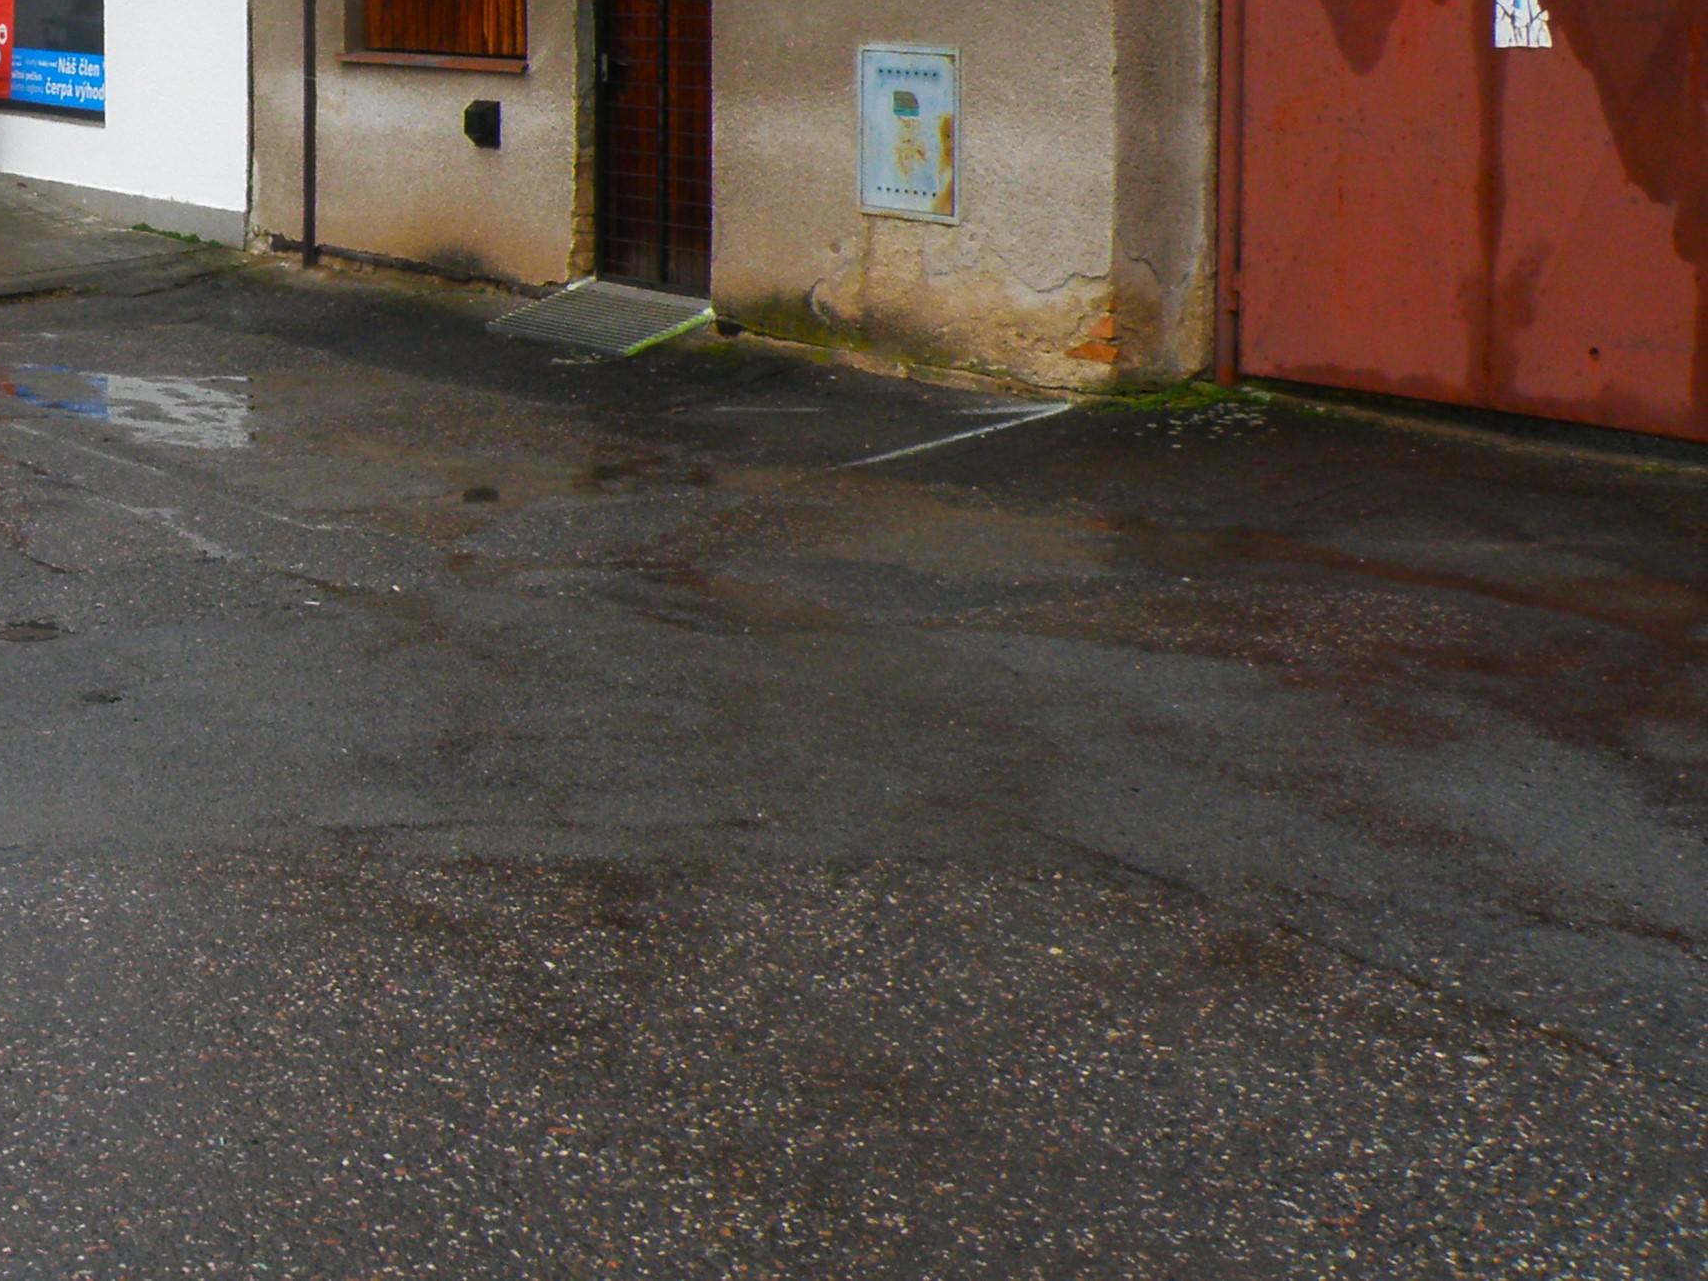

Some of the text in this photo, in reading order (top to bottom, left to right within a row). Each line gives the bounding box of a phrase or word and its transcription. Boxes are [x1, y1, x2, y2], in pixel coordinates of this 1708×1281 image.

[58, 57, 76, 75] Náš
[78, 58, 100, 77] člen
[45, 77, 72, 100] čerpá
